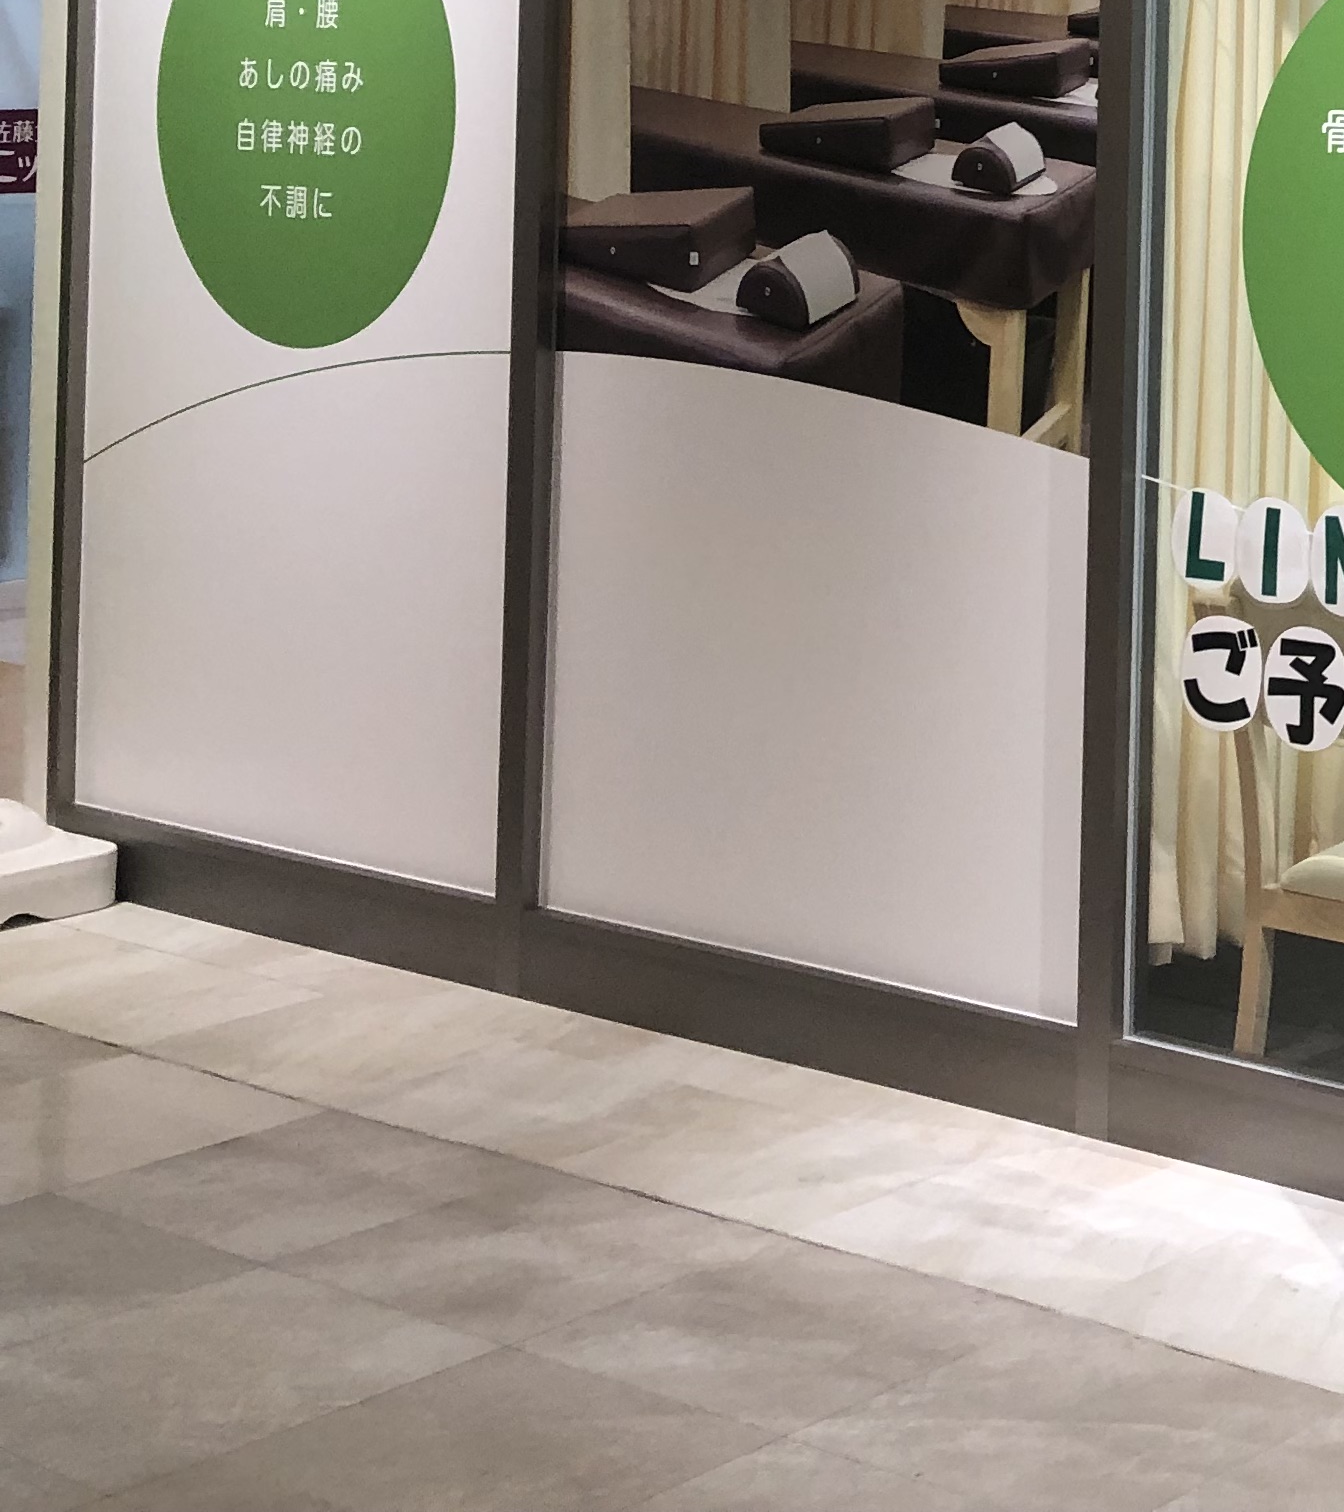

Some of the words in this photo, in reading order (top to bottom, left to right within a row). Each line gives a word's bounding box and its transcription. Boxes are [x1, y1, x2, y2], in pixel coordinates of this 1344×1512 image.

[238, 57, 365, 95] あしの痛み
[236, 119, 363, 157] 自律神経の
[260, 184, 333, 221] 不調に
